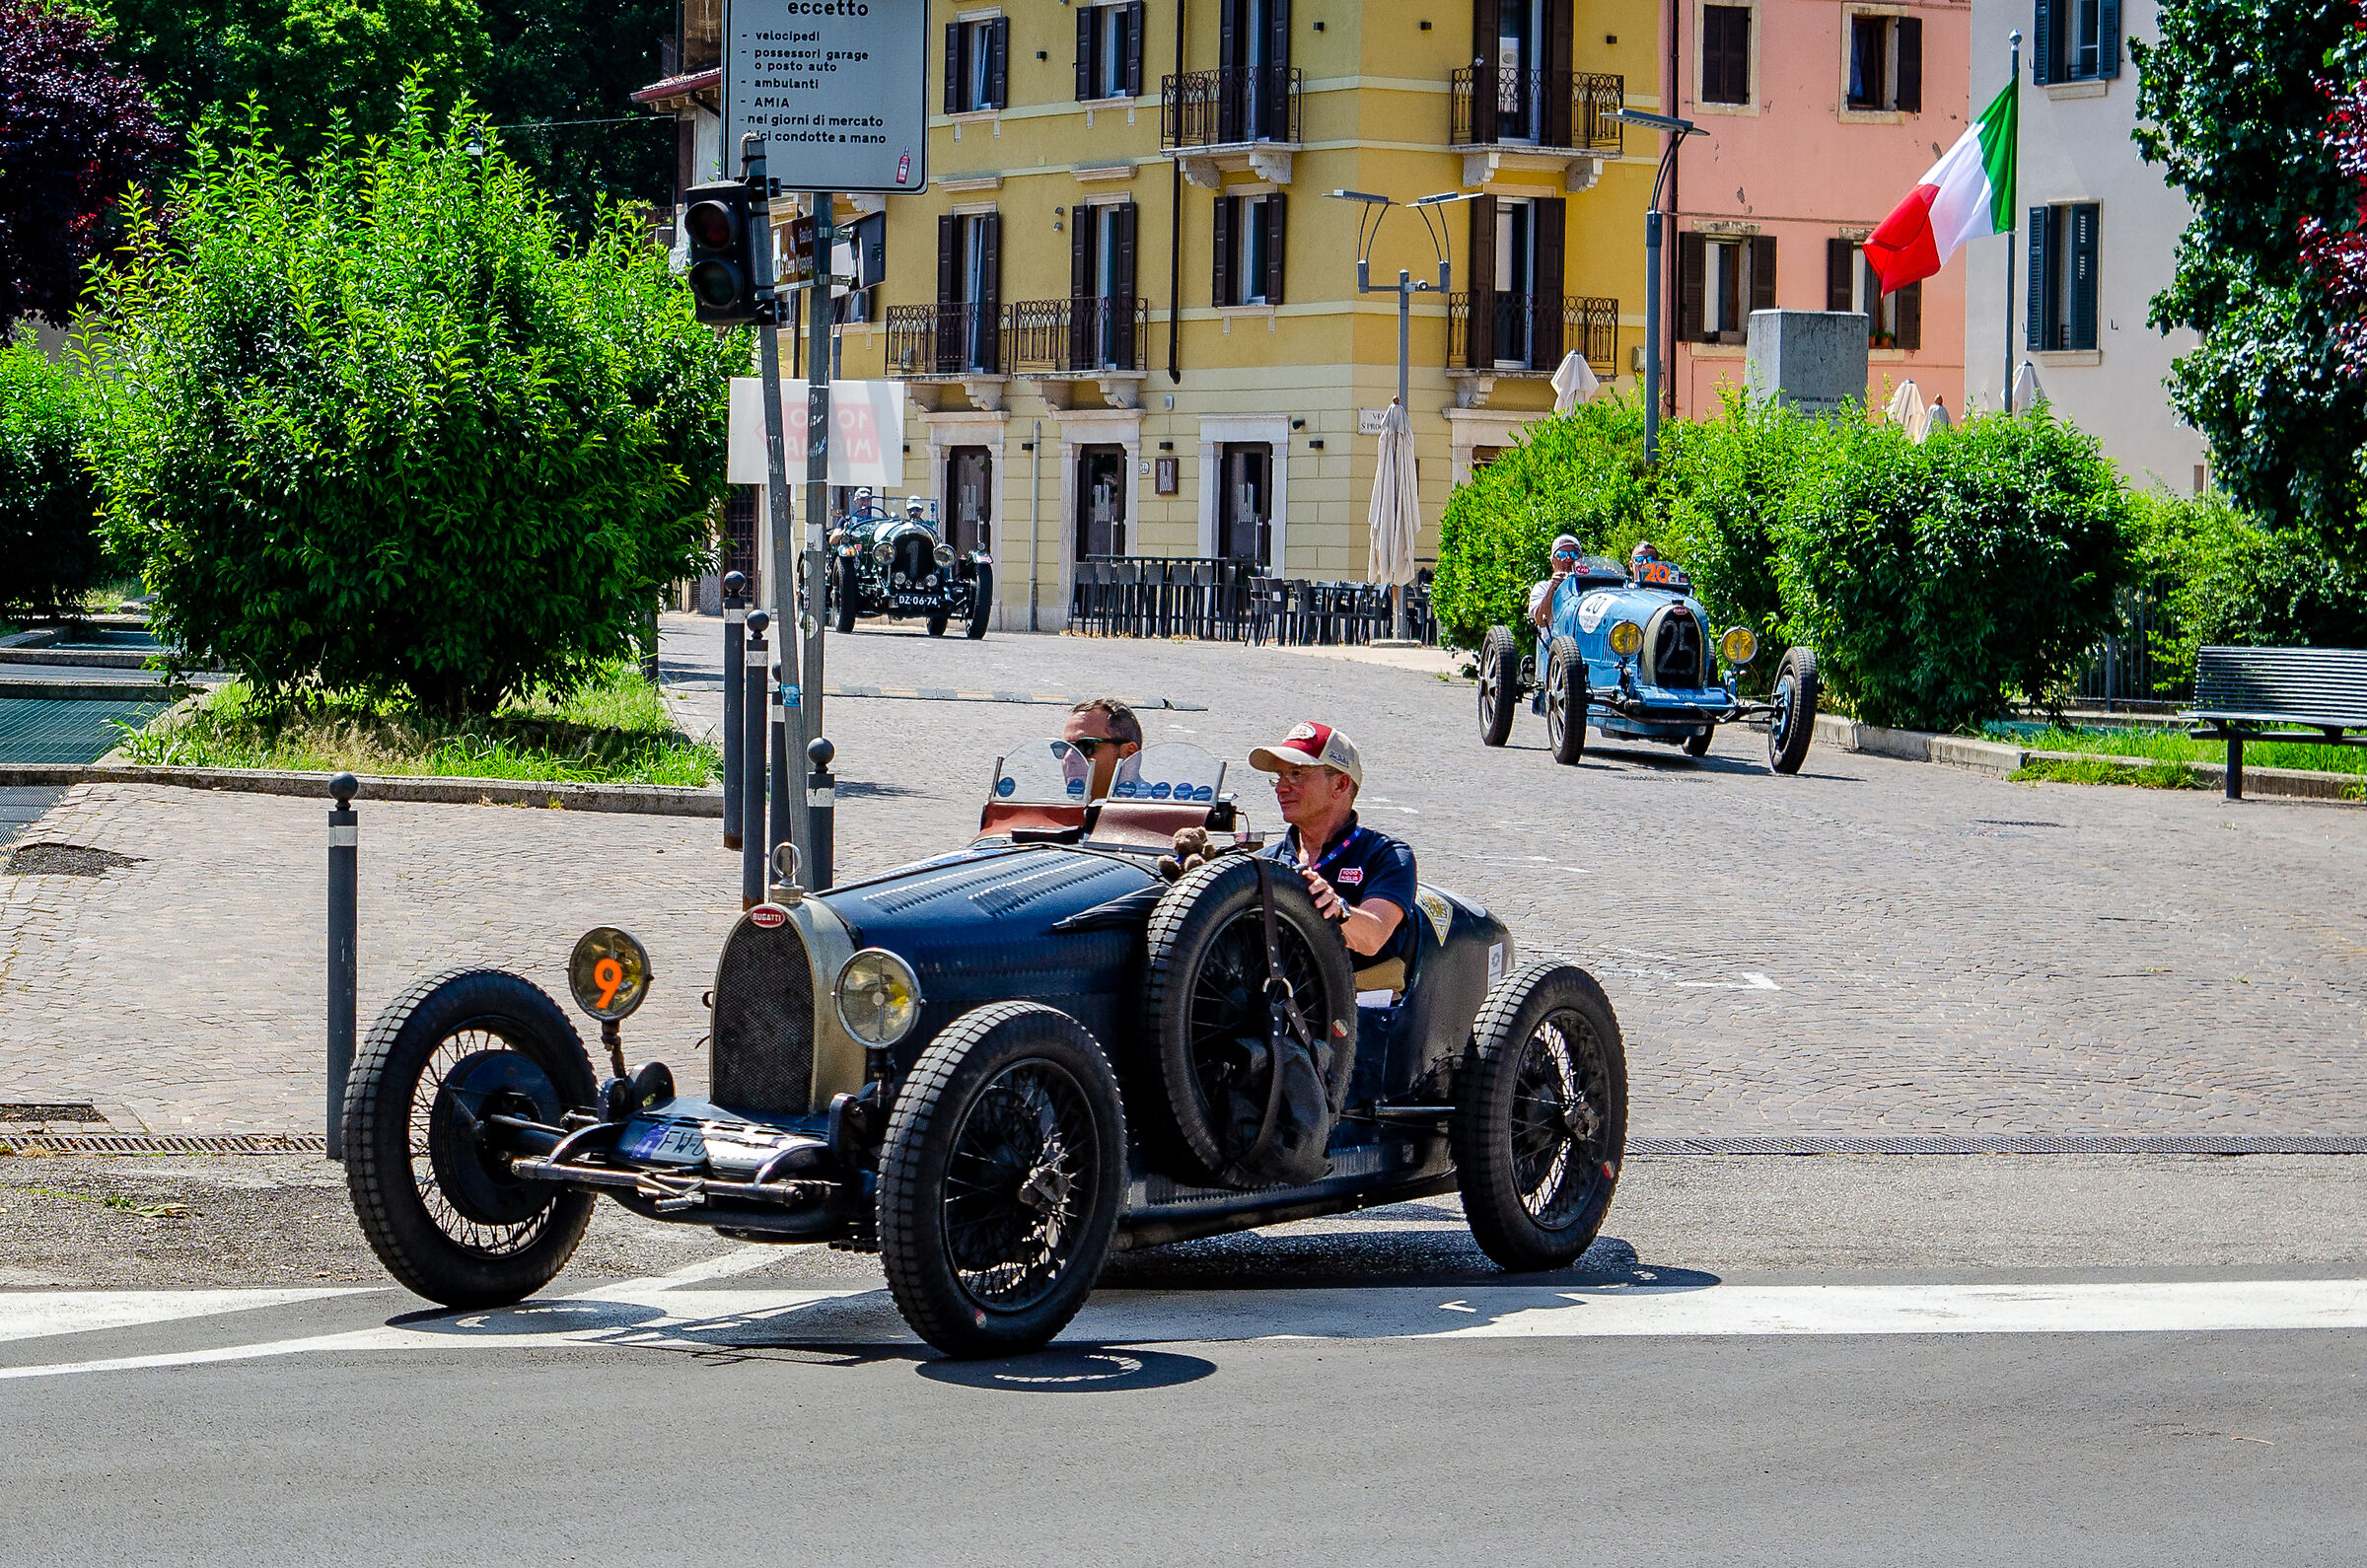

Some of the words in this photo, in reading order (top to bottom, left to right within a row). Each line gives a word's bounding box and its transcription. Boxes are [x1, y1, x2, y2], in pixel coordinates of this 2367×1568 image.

[788, 0, 869, 16] eccetto
[755, 30, 820, 42] velocipedi
[754, 48, 821, 59] possessori
[826, 51, 869, 61] garage
[754, 62, 762, 71] o
[768, 60, 803, 72] posto
[809, 62, 837, 71] auto
[754, 78, 819, 89] ambulanti
[754, 97, 790, 107] AMIA
[771, 113, 809, 126] giorni
[813, 114, 825, 125] di
[828, 115, 884, 126] mercato
[775, 131, 835, 143] condotte
[839, 134, 846, 143] a
[1644, 563, 1670, 584] 20
[1657, 619, 1696, 675] 25
[753, 912, 782, 922] BUGATTI
[594, 958, 622, 1009] 9
